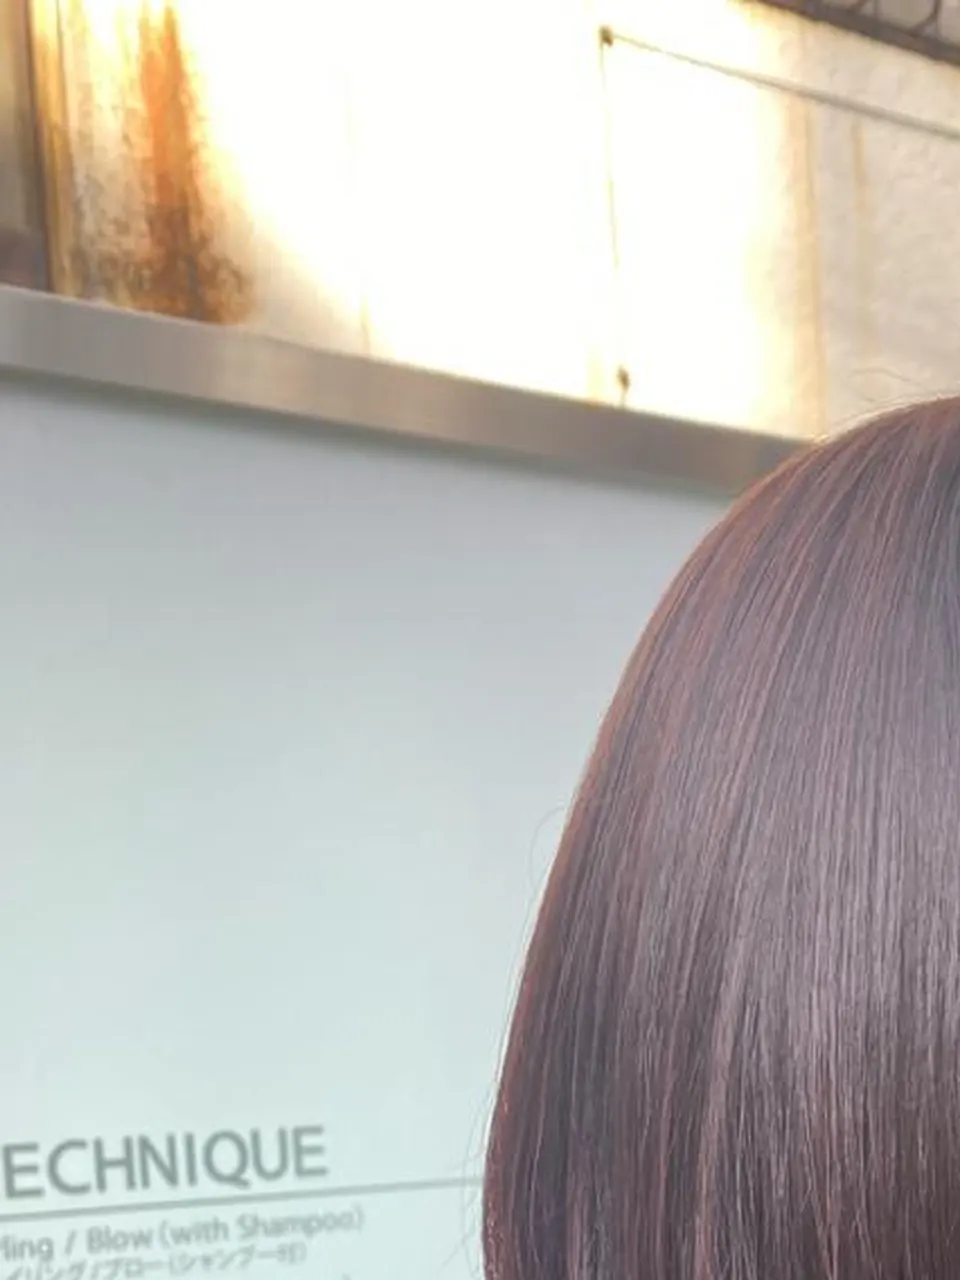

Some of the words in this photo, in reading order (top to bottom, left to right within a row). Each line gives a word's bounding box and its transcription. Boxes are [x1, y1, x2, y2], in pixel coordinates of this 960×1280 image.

[2, 1124, 330, 1199] ECHNIQUE
[0, 1232, 54, 1262] ling
[86, 1223, 153, 1254] Blow
